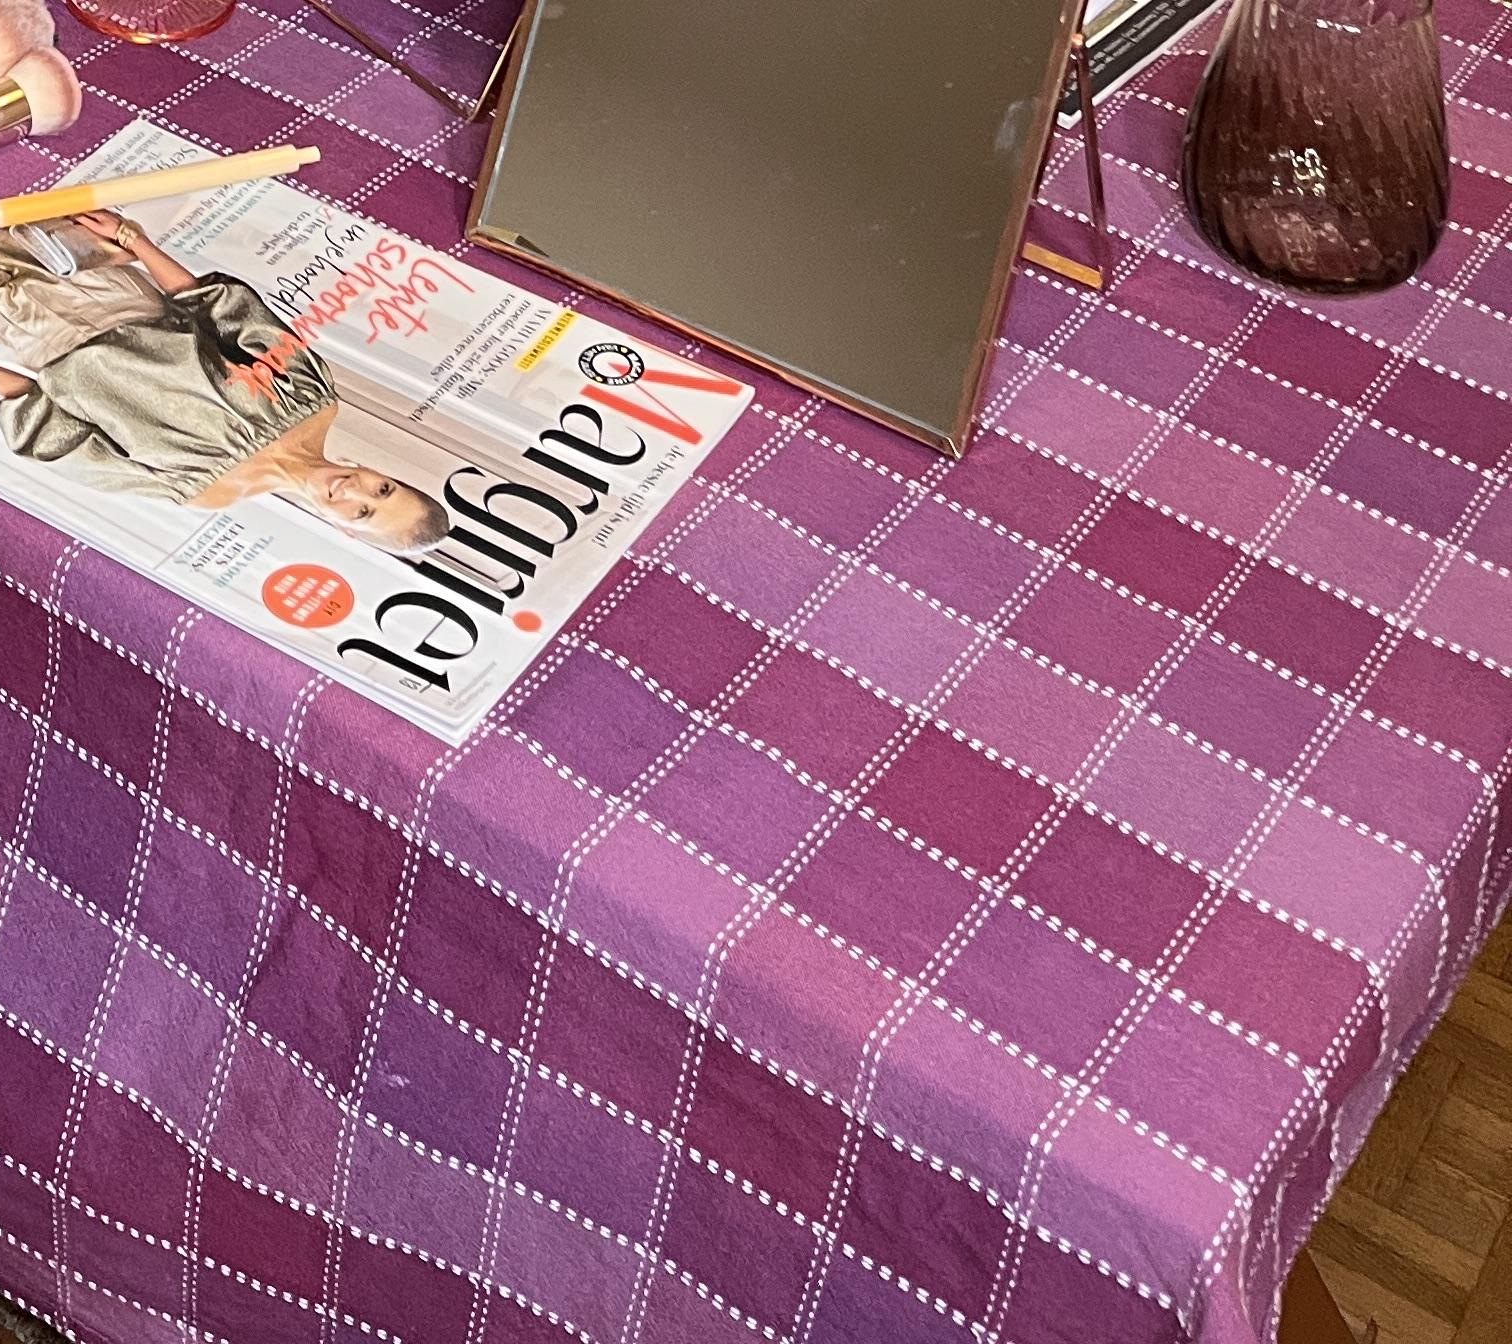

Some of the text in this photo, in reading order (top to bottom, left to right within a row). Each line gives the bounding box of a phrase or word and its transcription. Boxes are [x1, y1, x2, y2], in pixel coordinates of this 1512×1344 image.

[263, 216, 327, 267] Het fijne van
[469, 292, 520, 336] verbazen
[491, 298, 538, 338] moeder
[450, 333, 477, 355] over
[456, 350, 487, 374] zich
[405, 369, 466, 425] fantastisch
[635, 459, 674, 495] beste
[337, 335, 745, 700] Margriet
[607, 511, 631, 528] is
[613, 488, 648, 516] tijd
[319, 599, 343, 617] DIY
